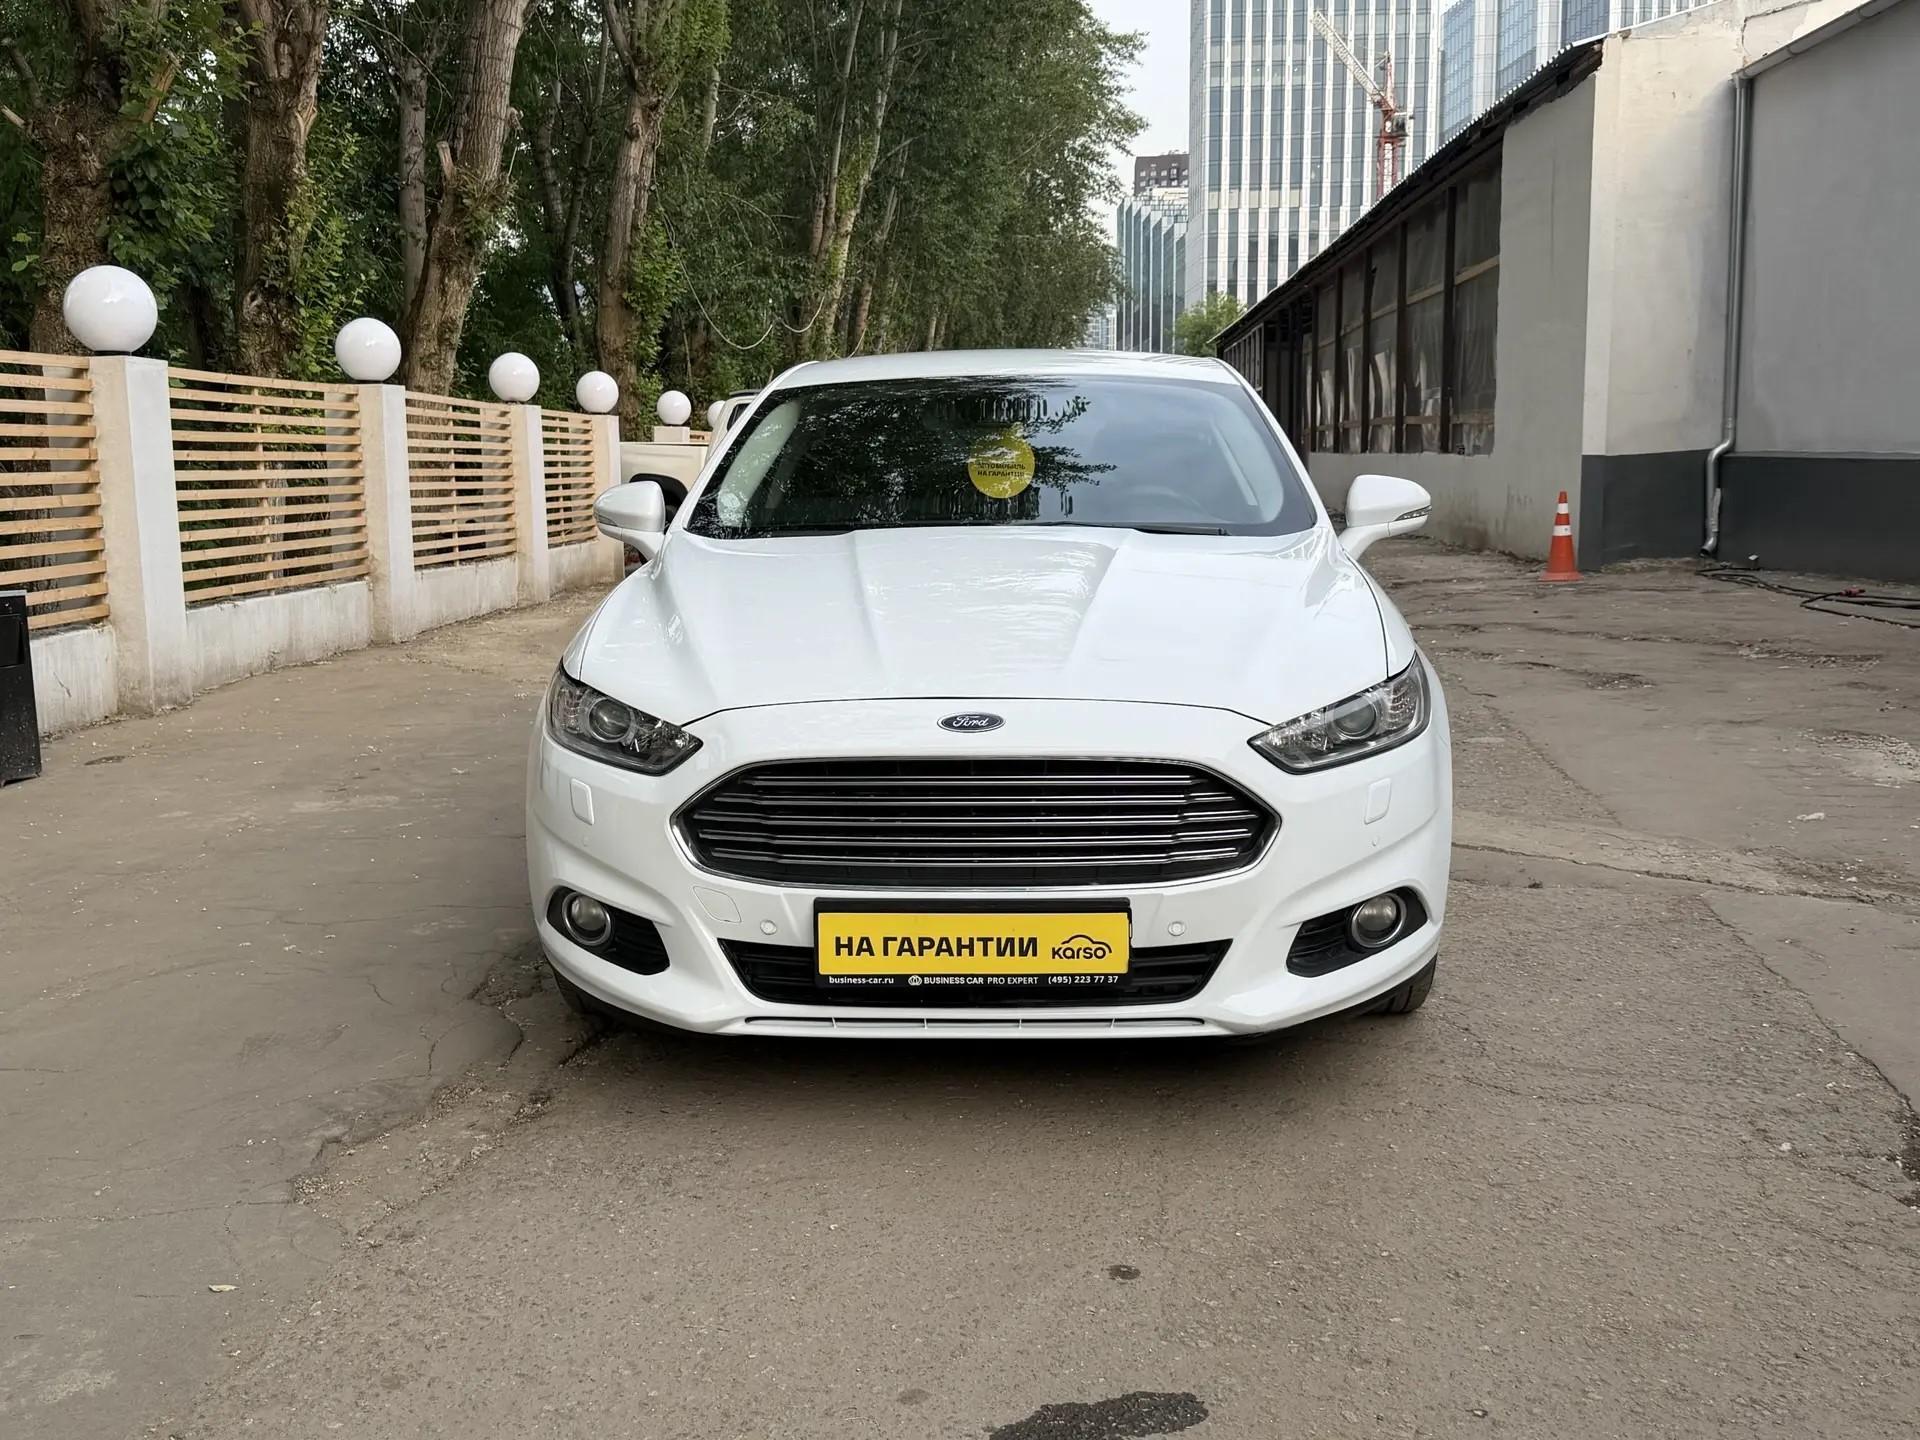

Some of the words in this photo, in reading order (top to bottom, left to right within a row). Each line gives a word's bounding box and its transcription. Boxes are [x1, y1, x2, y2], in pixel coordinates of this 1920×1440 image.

[952, 715, 989, 727] Ford
[835, 936, 875, 957] НА
[882, 936, 1038, 957] ГАРАНТИИ
[828, 976, 894, 984] business-car.ru
[923, 976, 965, 985] BUSINESS
[966, 976, 984, 985] CAR
[987, 976, 1005, 985] PRO
[1007, 976, 1039, 985] EXPERT
[1047, 975, 1072, 985] (495)
[1074, 975, 1091, 984] 223
[1093, 975, 1105, 984] 77
[1107, 975, 1119, 984] 37
